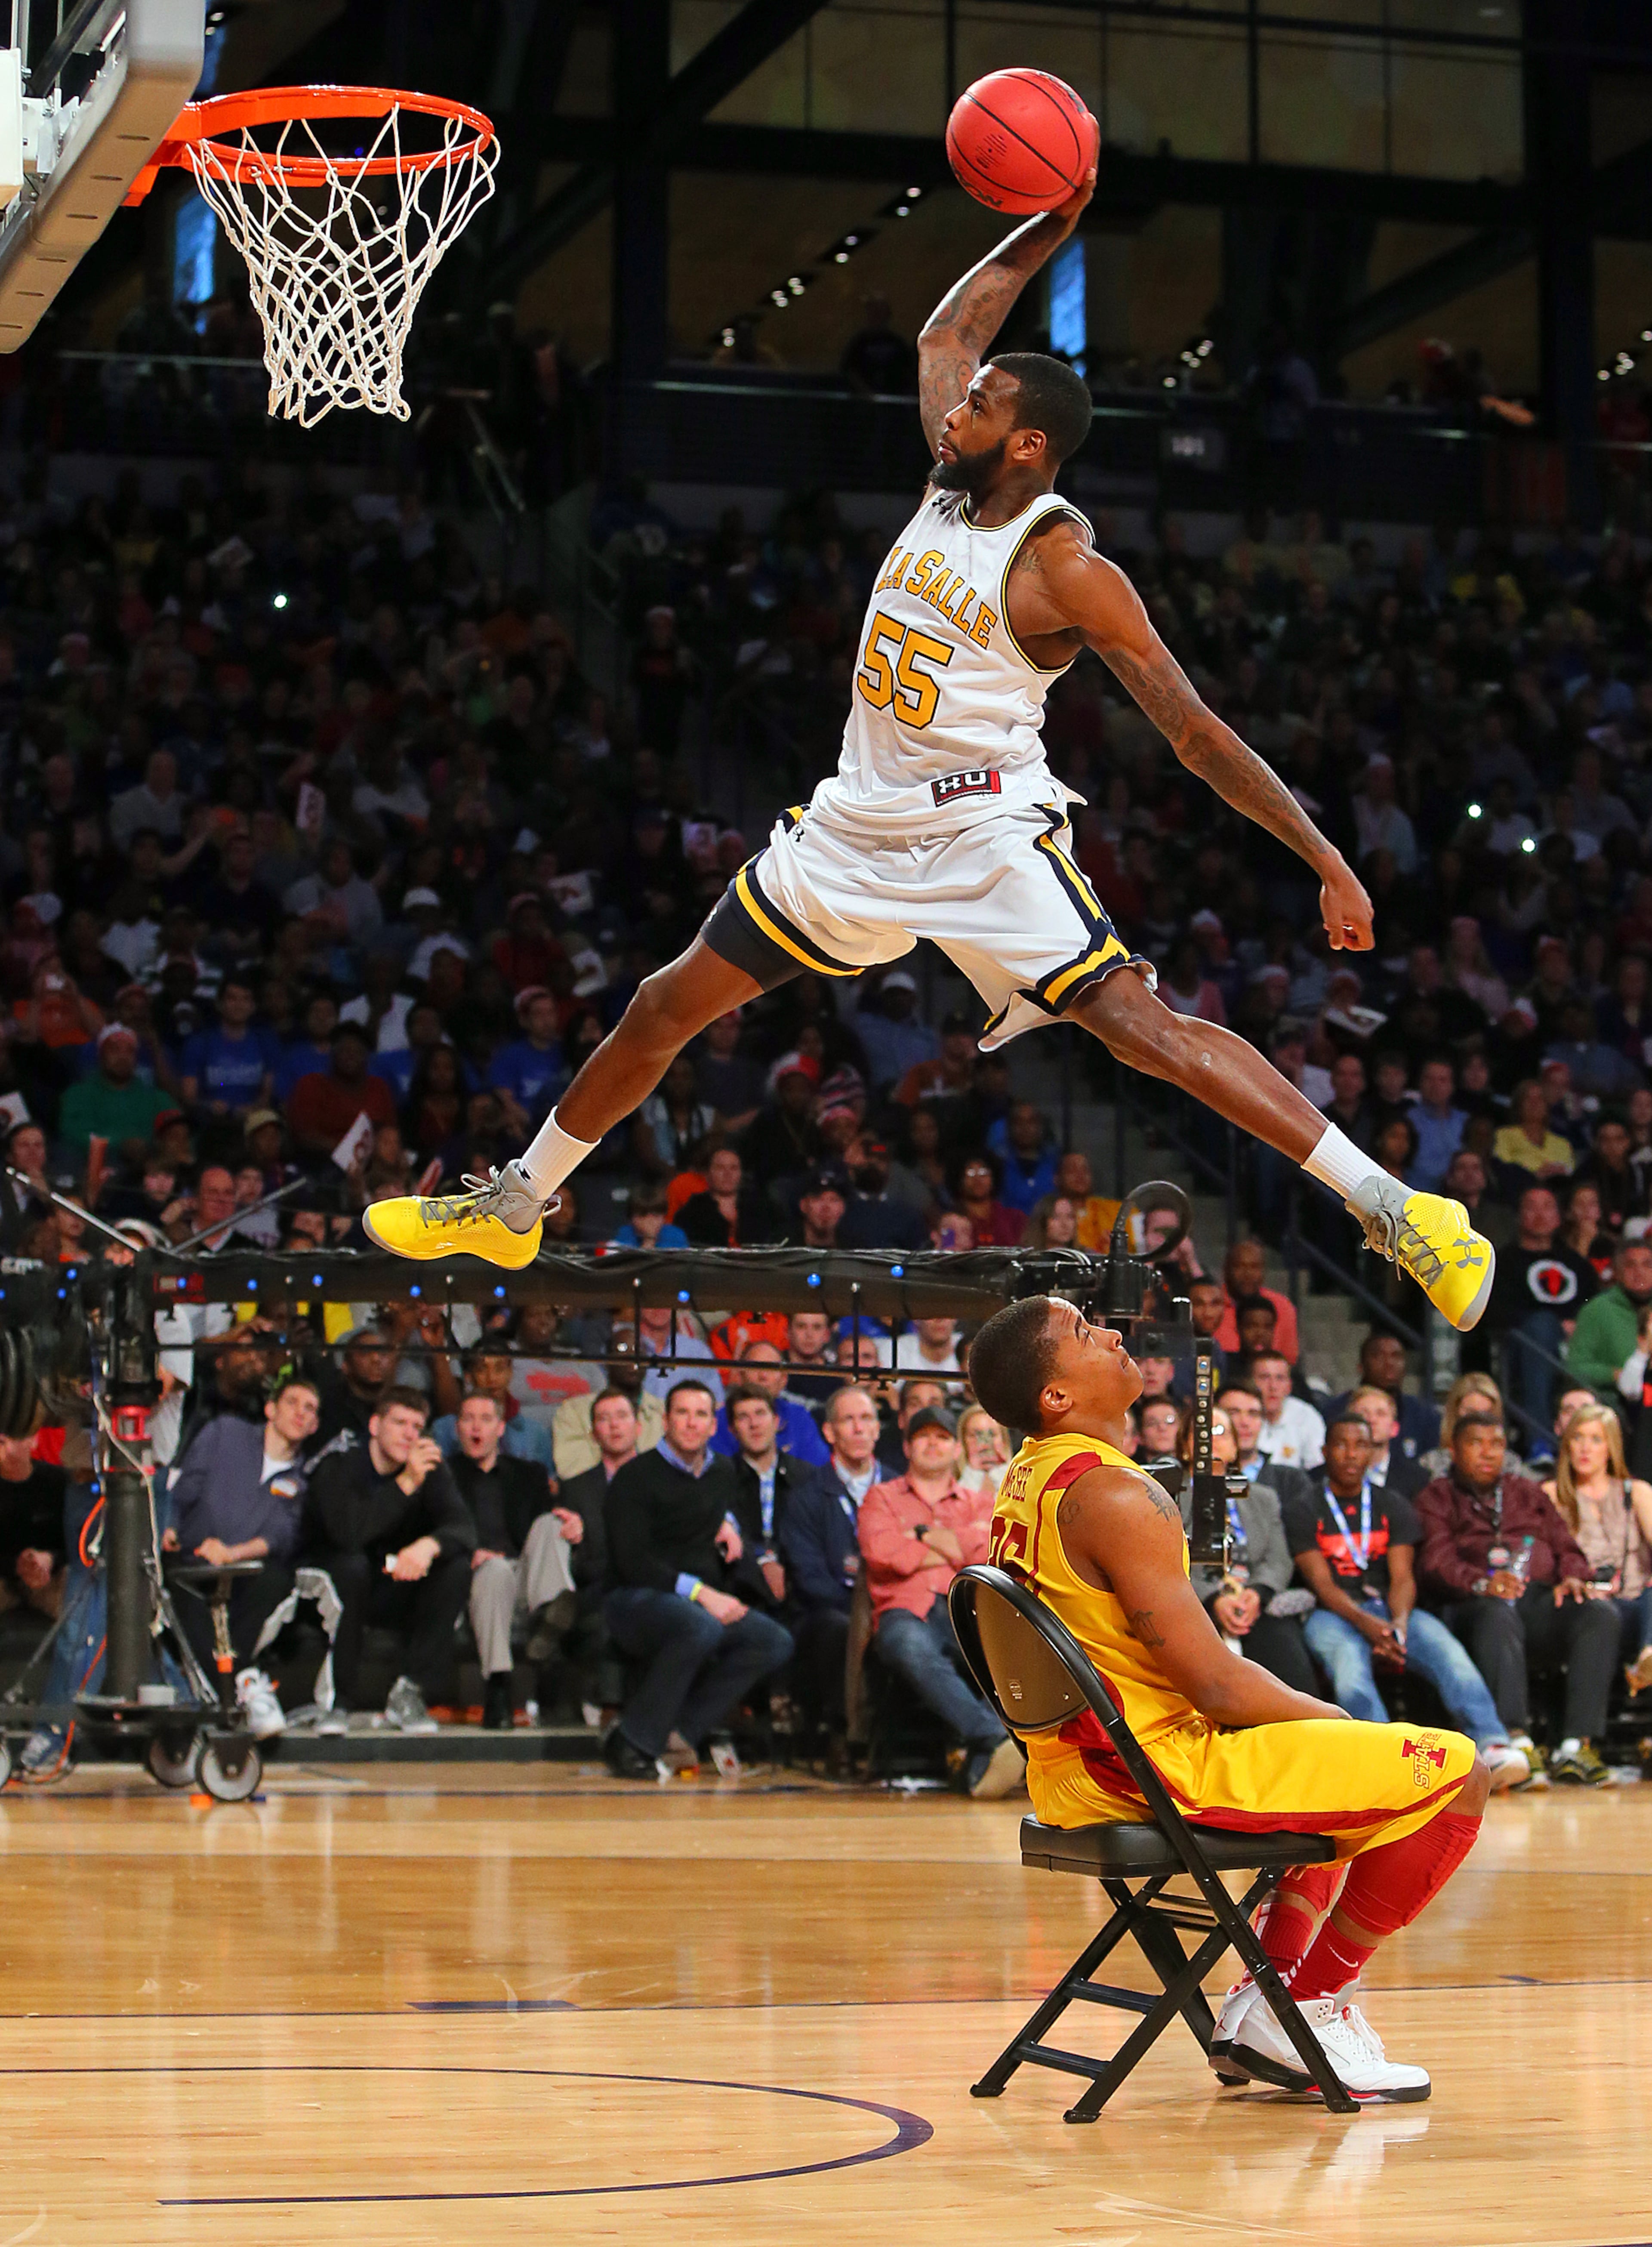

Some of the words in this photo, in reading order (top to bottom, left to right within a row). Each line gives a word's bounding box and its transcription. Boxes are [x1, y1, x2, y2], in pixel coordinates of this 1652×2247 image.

[875, 546, 914, 593] LA
[905, 549, 998, 650] SALLE
[857, 610, 954, 730] 55
[1414, 1732, 1442, 1789] STATE
